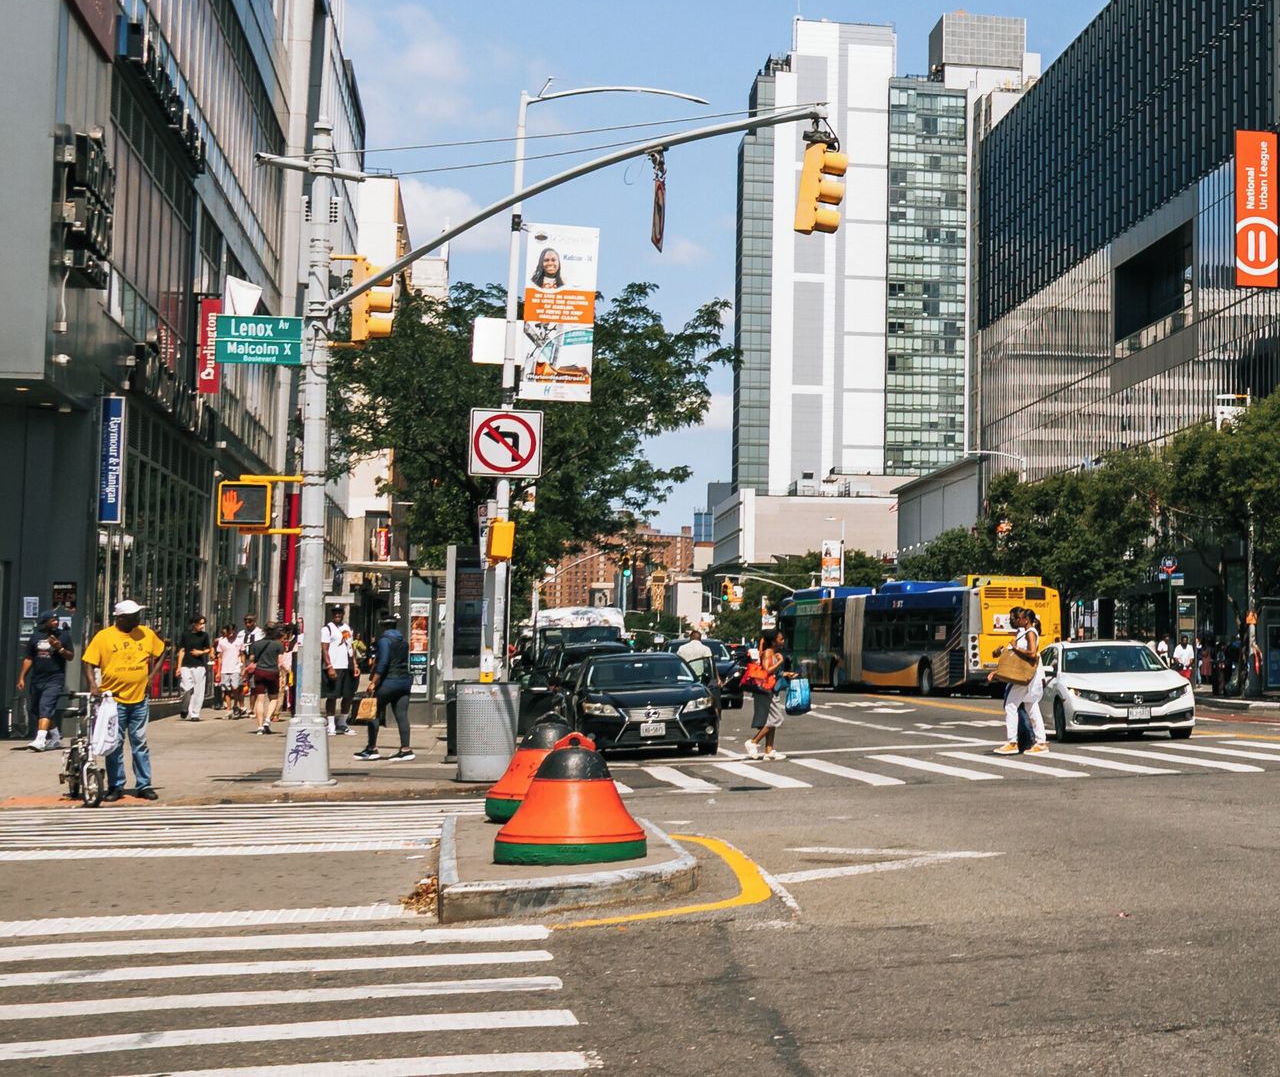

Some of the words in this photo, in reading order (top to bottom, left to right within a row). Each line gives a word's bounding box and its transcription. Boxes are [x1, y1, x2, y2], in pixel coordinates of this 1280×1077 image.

[1258, 141, 1268, 176] League
[1246, 167, 1255, 210] National
[1258, 180, 1268, 210] Urban
[231, 318, 273, 336] Lenox
[279, 320, 289, 330] Av
[200, 312, 217, 380] Burlington
[227, 342, 278, 355] Malcolm
[283, 343, 292, 355] X
[108, 416, 121, 456] Raymour
[109, 457, 120, 465] &
[106, 465, 120, 504] Flanigan
